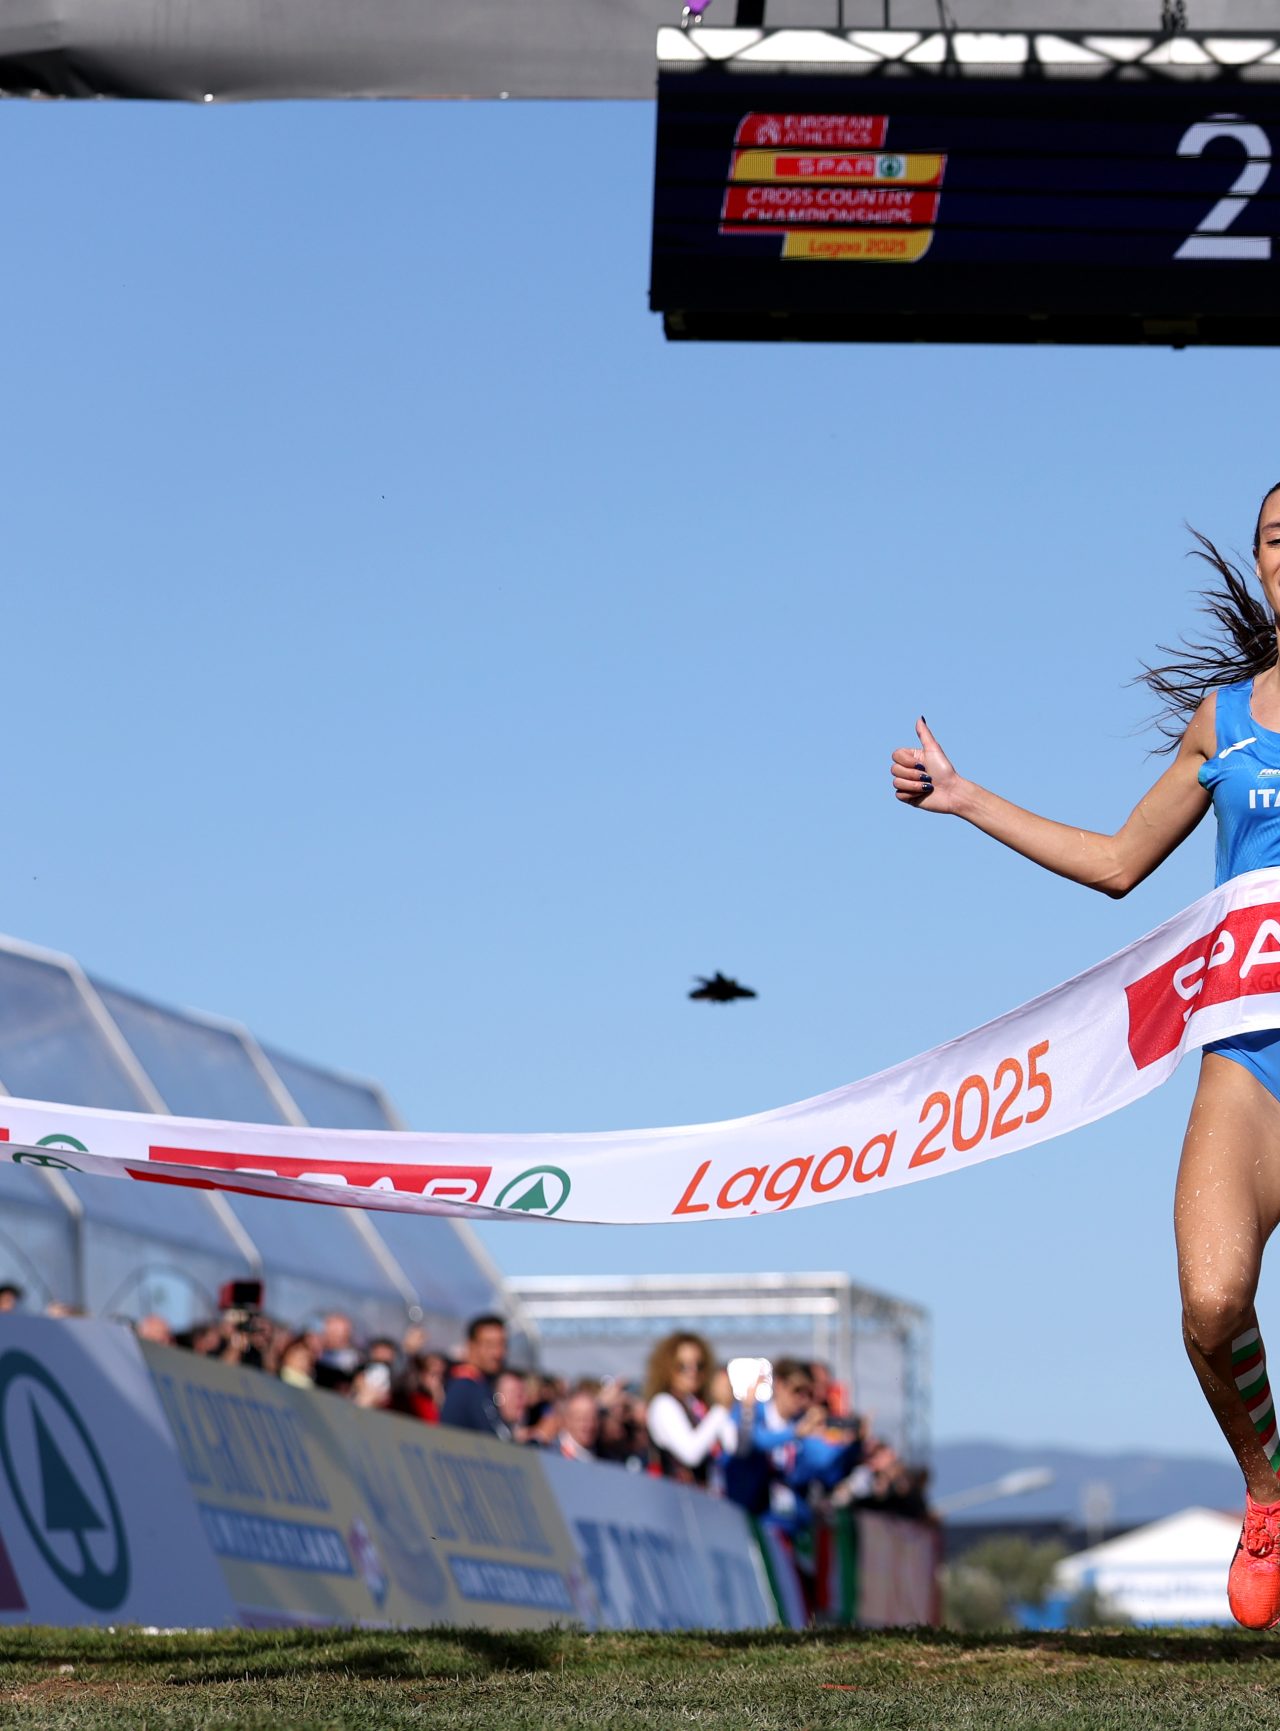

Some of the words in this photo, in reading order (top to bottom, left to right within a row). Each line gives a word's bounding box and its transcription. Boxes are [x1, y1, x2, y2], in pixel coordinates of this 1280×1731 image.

[797, 159, 873, 174] SPAR
[747, 188, 812, 204] CROSS
[816, 188, 914, 206] COUNTRY
[671, 1130, 898, 1215] Lagoa
[907, 1039, 1053, 1169] 2025
